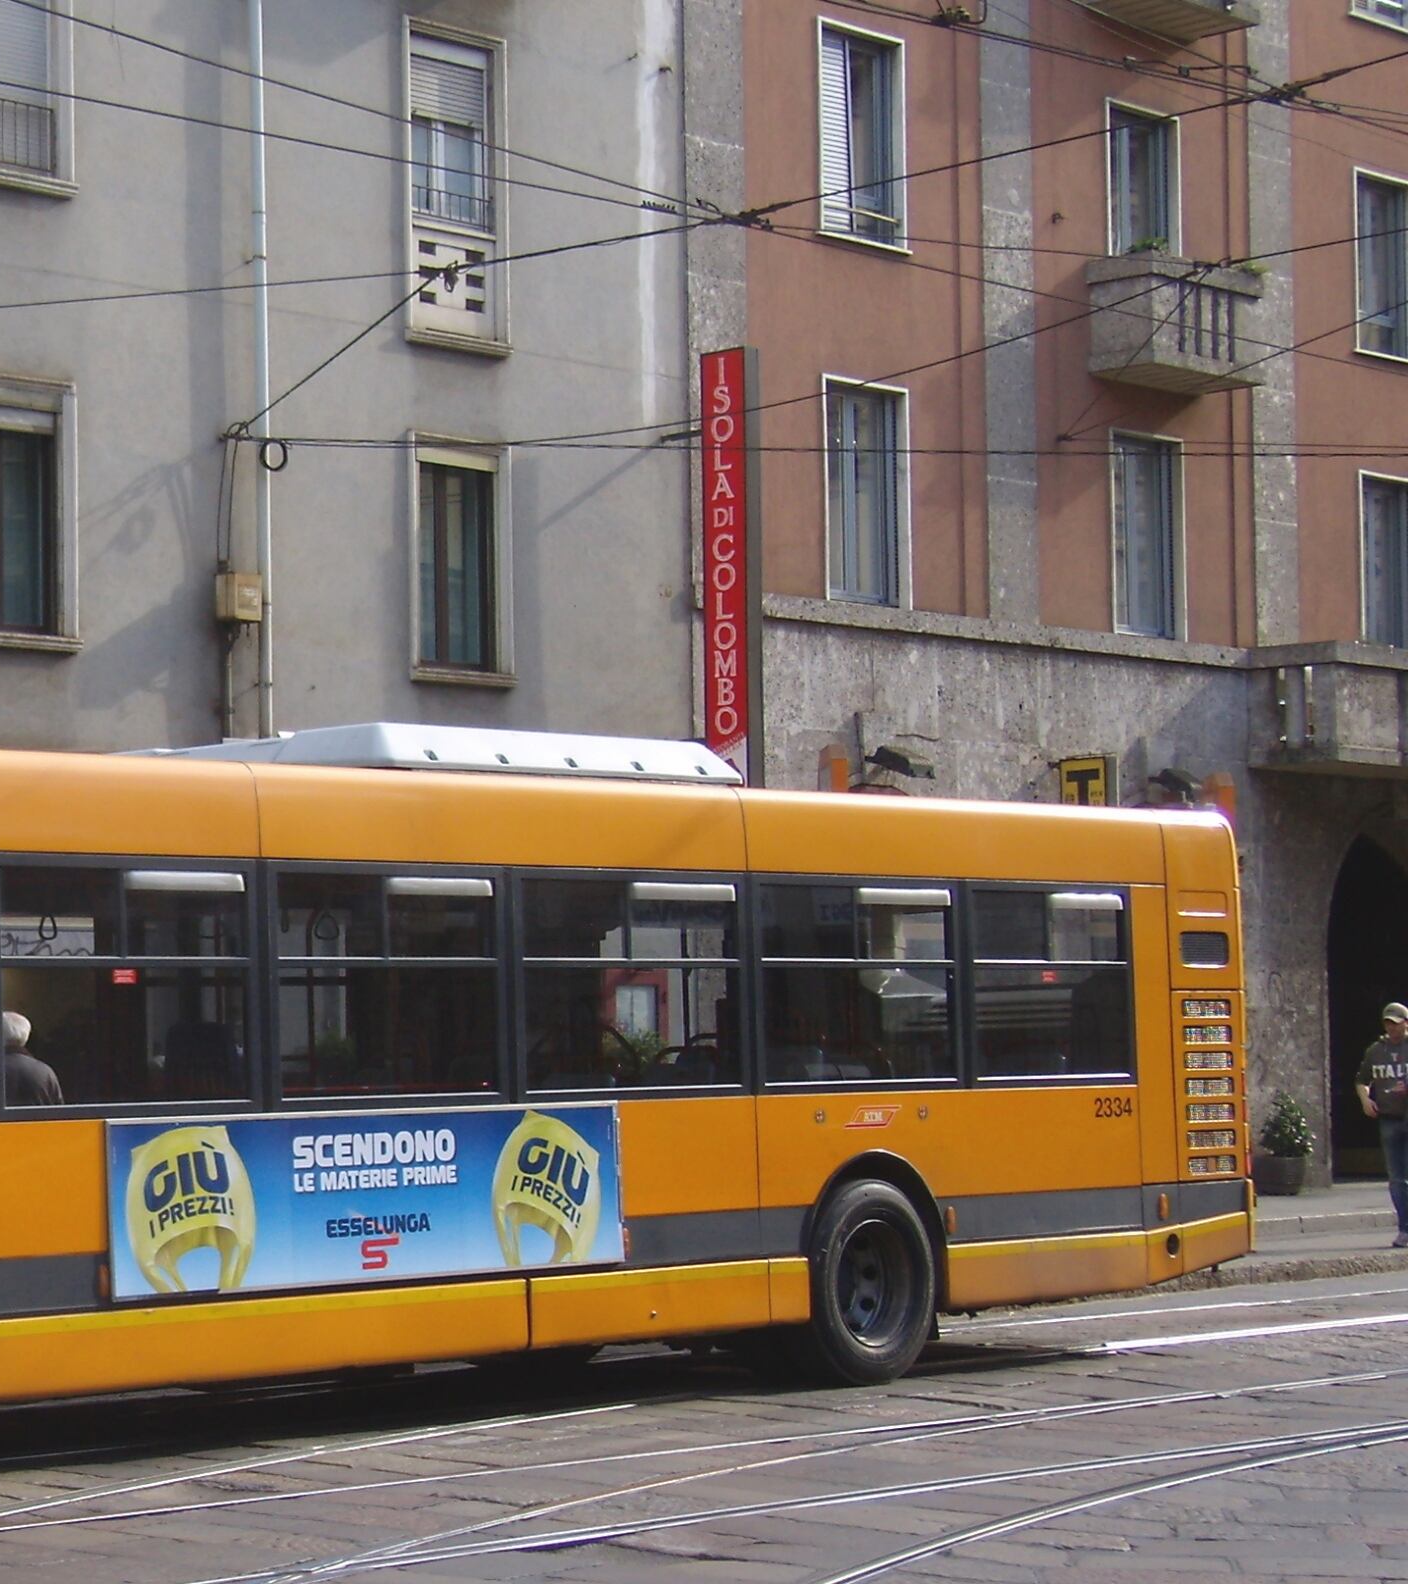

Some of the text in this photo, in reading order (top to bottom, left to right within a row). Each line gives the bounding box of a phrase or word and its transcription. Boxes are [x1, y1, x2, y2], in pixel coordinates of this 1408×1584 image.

[711, 357, 734, 501] ISOLA
[713, 506, 734, 528] DI
[712, 533, 738, 735] COLOMBO
[1094, 1096, 1133, 1118] 2334
[293, 1129, 456, 1169] SCENDONO
[144, 1141, 230, 1213] GIÙ
[294, 1165, 457, 1193] LE MATERIE PRIME
[517, 1137, 590, 1207] GIÙ
[326, 1213, 431, 1238] ESSELUNGA
